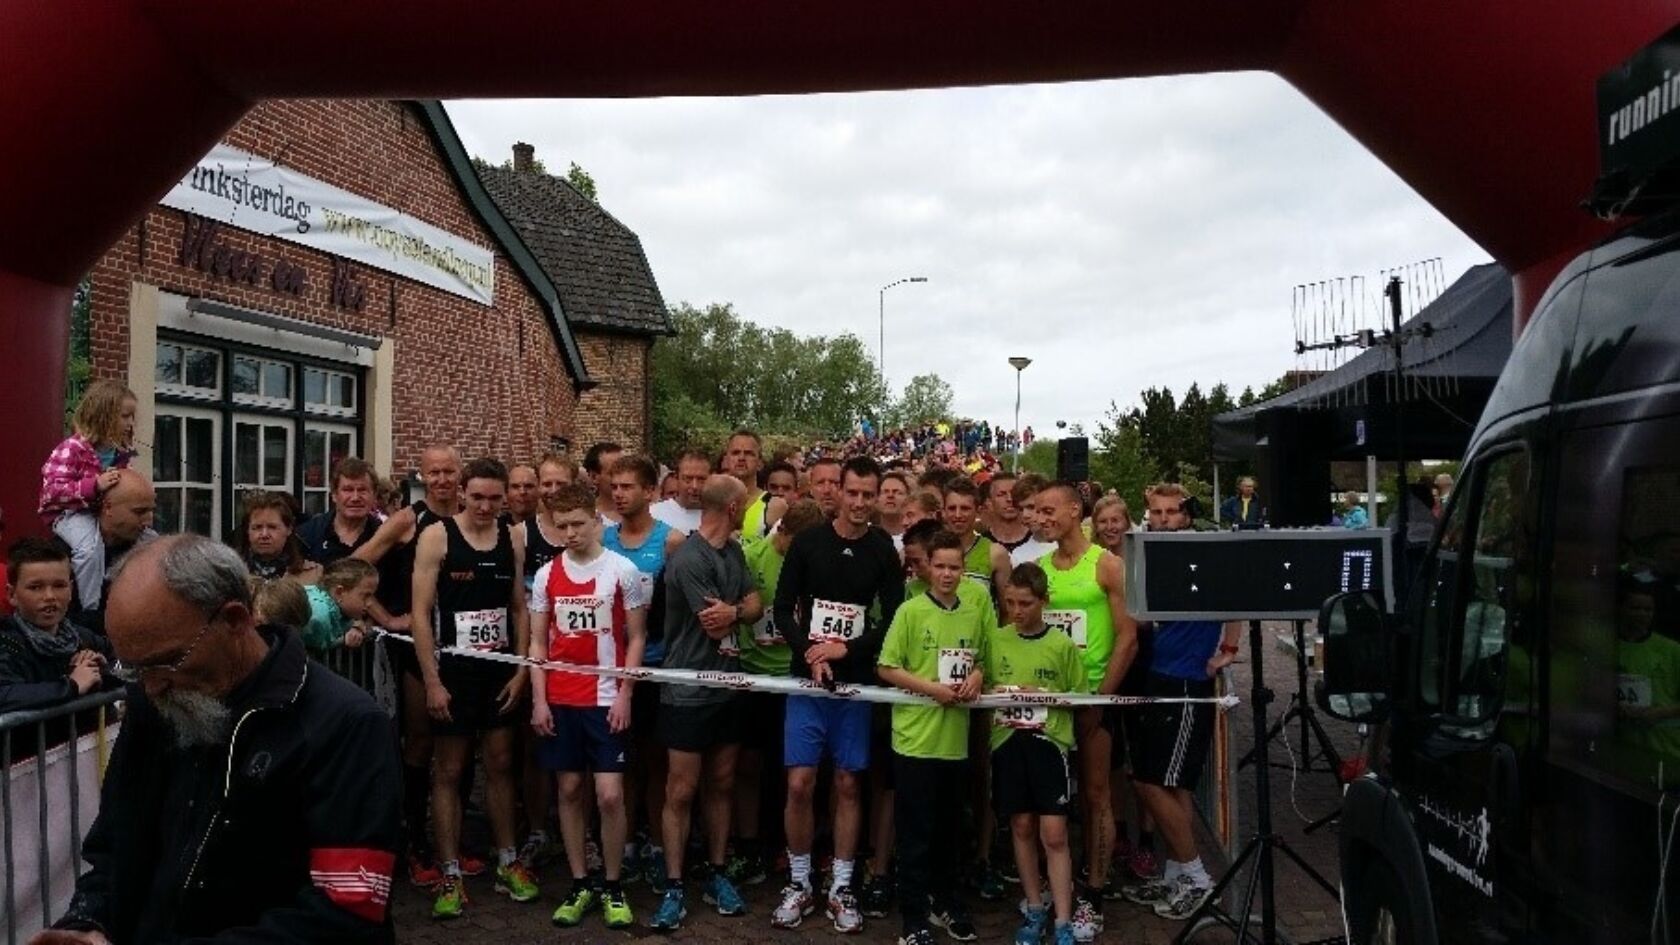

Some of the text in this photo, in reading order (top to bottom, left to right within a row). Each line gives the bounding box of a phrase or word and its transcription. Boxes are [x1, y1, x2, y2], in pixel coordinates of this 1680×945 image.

[180, 163, 311, 233] inksterdag
[568, 611, 596, 630] 211
[822, 617, 853, 637] 548
[469, 624, 500, 643] 563
